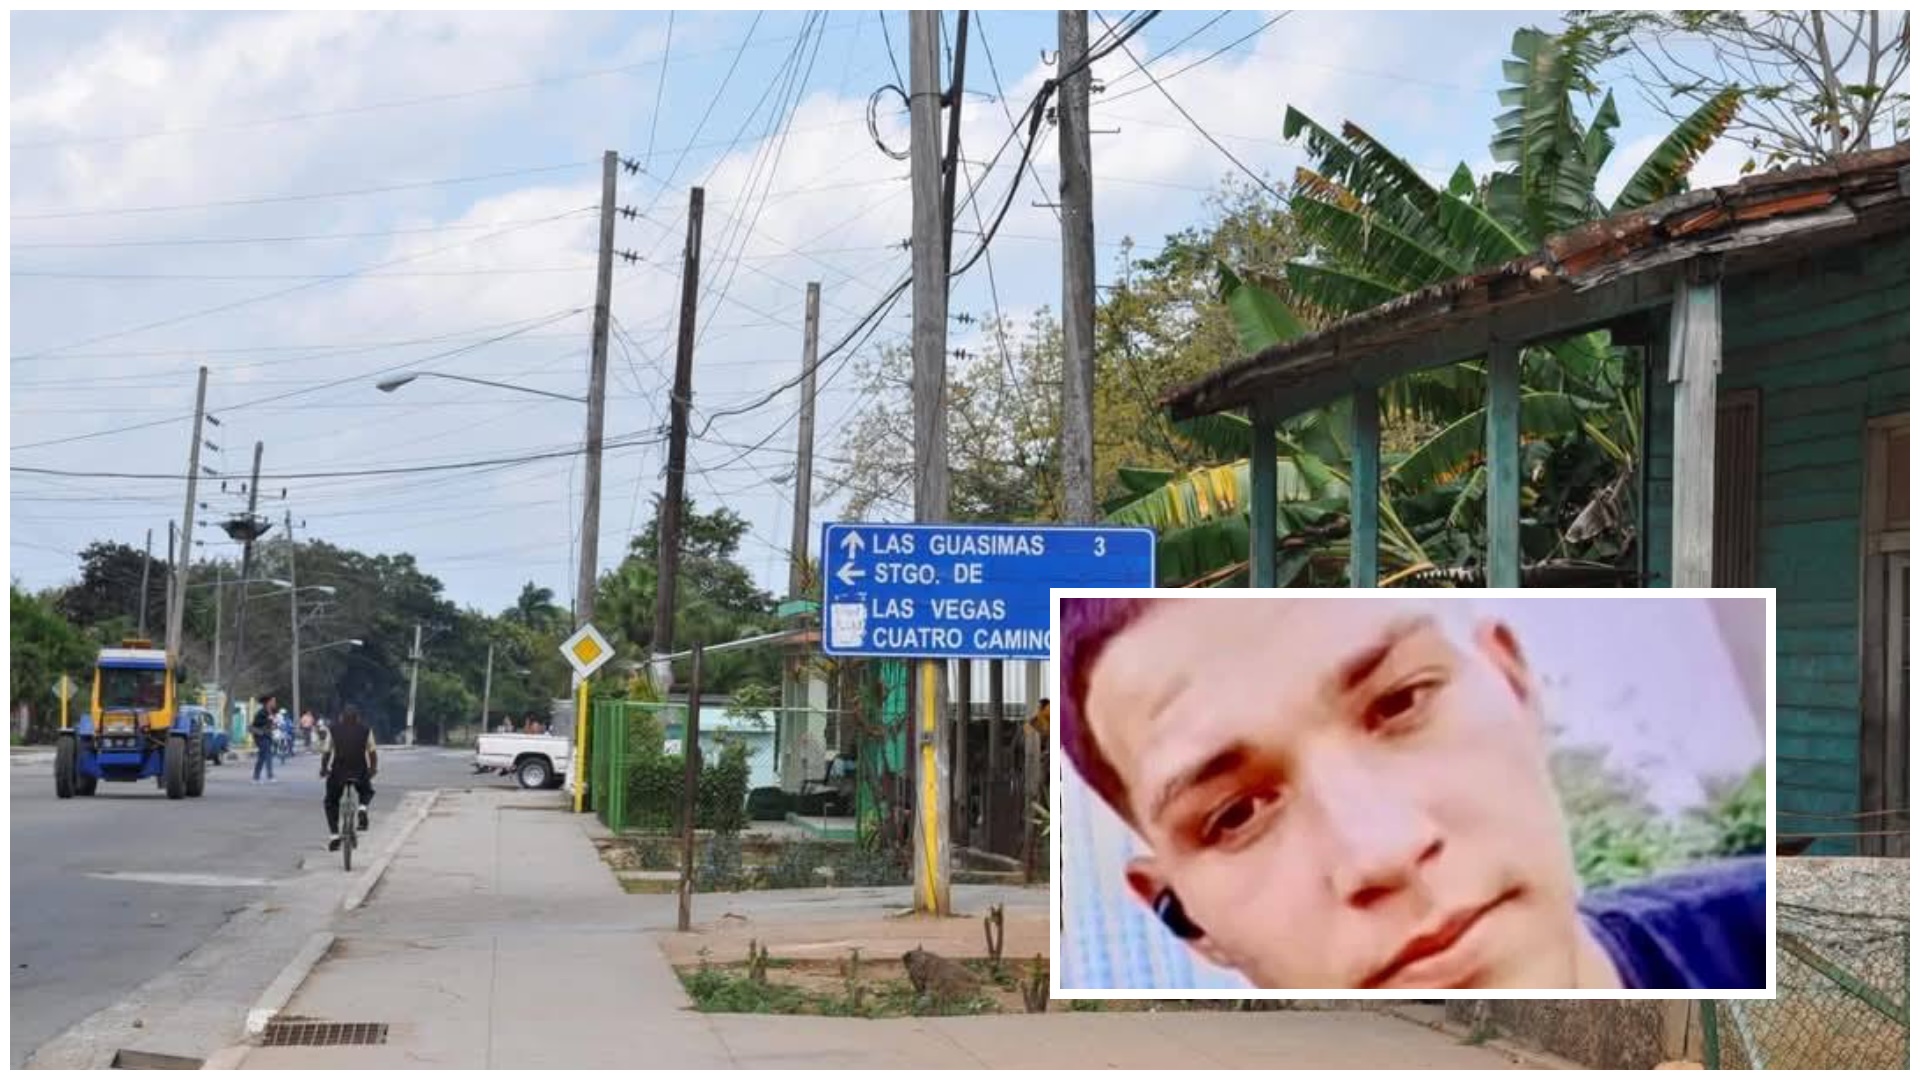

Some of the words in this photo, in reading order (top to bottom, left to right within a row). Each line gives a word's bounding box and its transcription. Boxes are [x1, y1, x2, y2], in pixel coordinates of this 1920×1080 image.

[872, 534, 915, 555] LAS
[929, 535, 1044, 556] GUASIMAS
[1093, 536, 1106, 557] 3
[874, 563, 940, 584] STGO.
[954, 564, 982, 583] DE
[872, 598, 914, 619] LAS
[931, 599, 1006, 620] VEGAS
[873, 627, 962, 648] CUATRO
